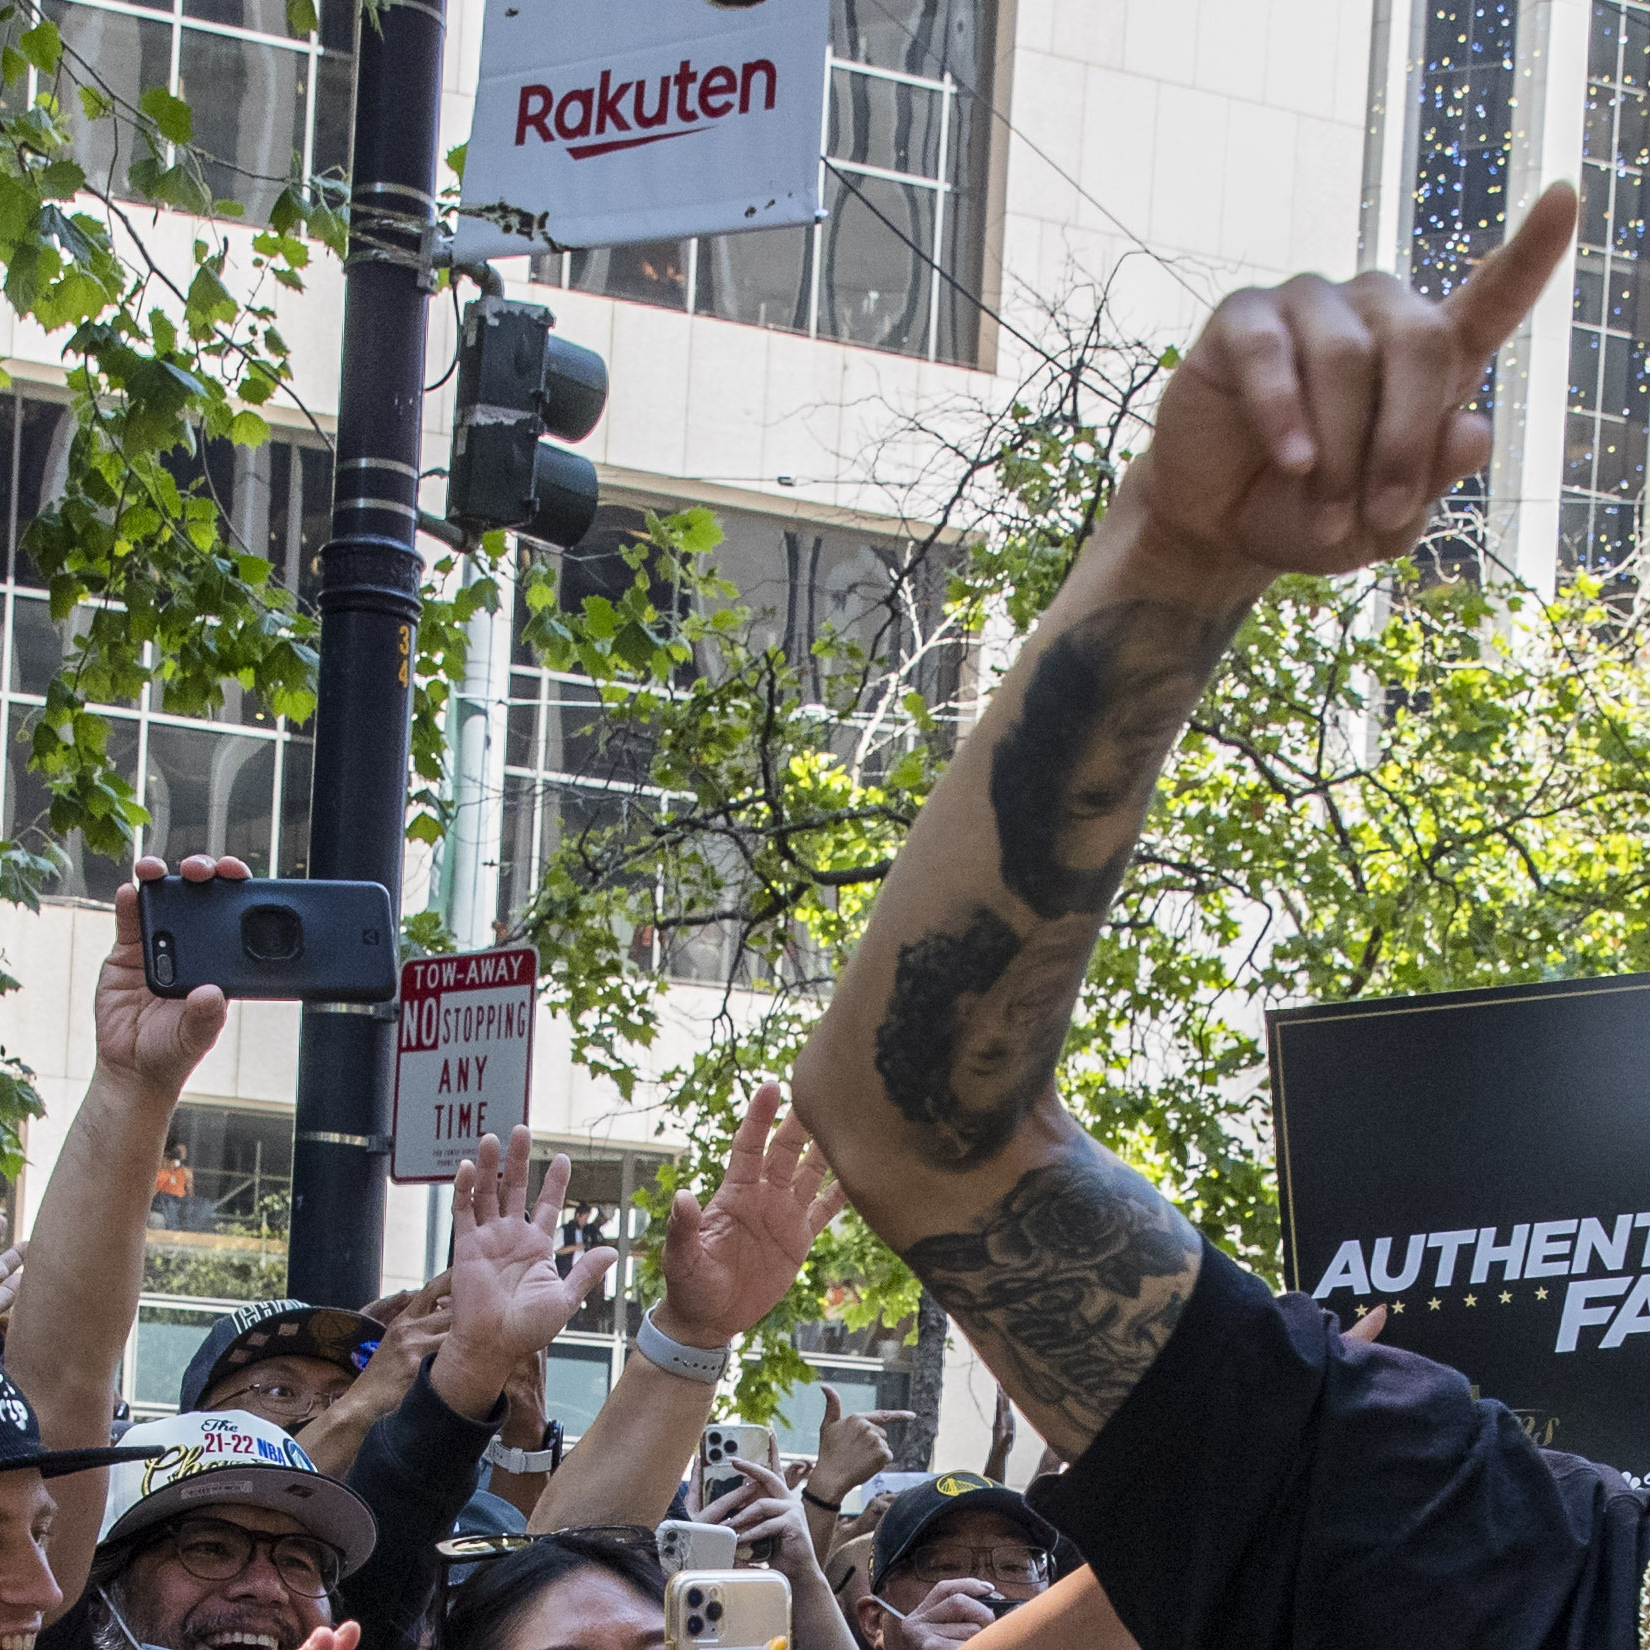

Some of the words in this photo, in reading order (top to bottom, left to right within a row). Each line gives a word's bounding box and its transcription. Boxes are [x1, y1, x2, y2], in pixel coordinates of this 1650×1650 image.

[514, 57, 777, 147] Rakuten
[415, 955, 524, 990] TOW-AWAY
[402, 997, 438, 1049] NO
[443, 1001, 526, 1044] STOPPING
[438, 1056, 488, 1094] ANY
[434, 1102, 489, 1140] TIME
[201, 1419, 239, 1433] The
[203, 1432, 255, 1455] 21-22
[256, 1437, 287, 1464] NBA
